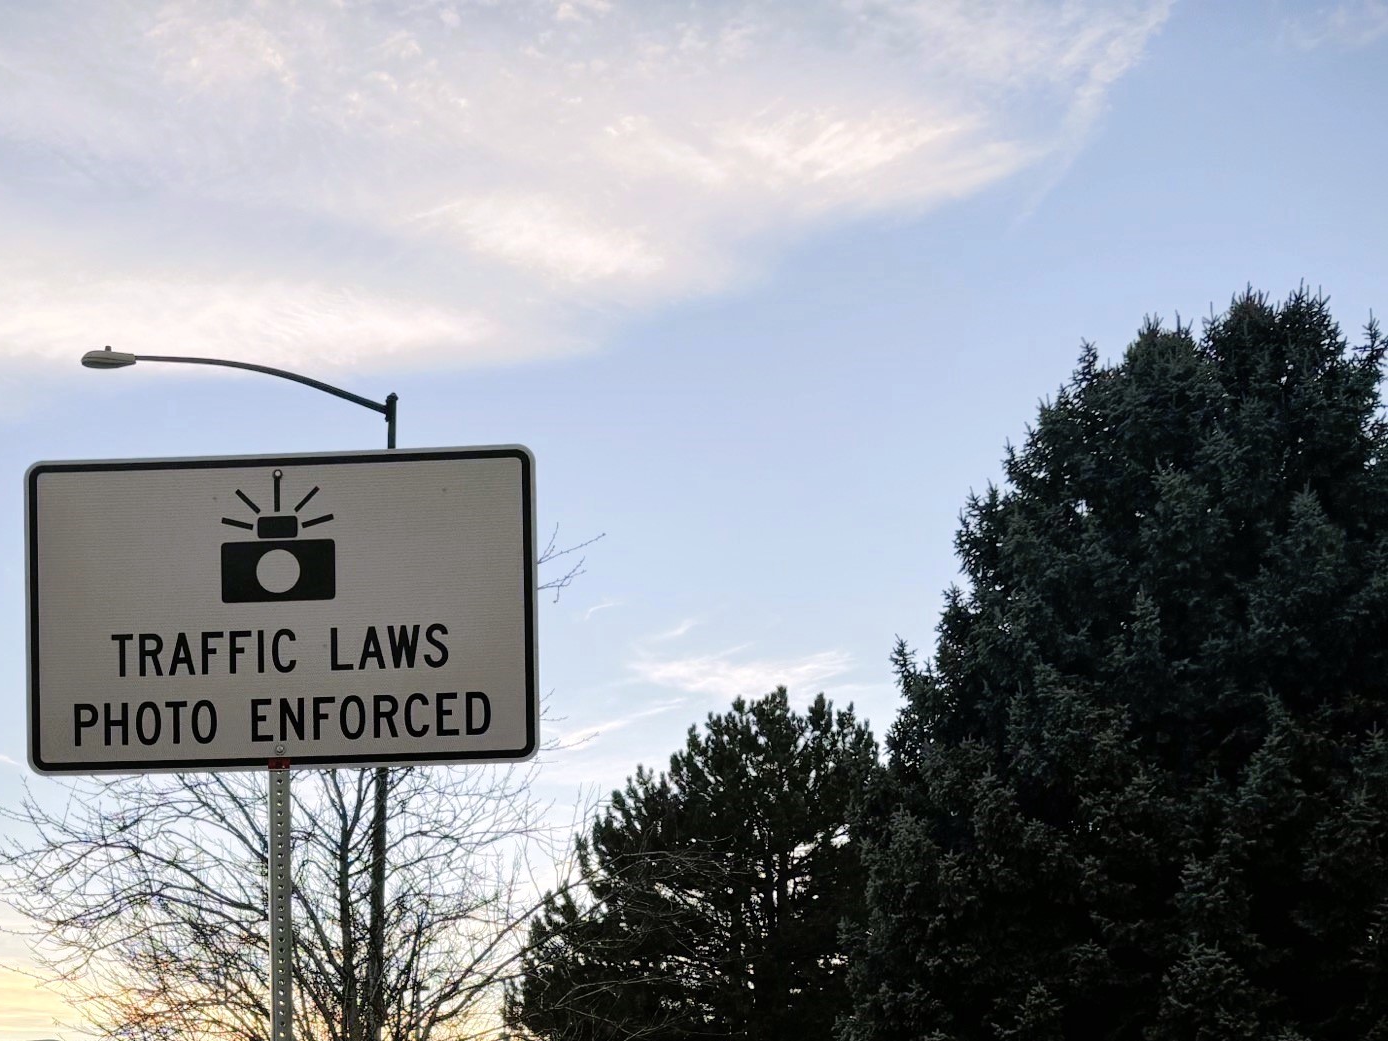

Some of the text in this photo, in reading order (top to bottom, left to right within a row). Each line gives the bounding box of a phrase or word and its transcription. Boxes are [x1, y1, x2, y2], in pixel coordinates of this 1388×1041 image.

[110, 622, 449, 678] TRAFFIC LAWS
[72, 691, 492, 748] PHOTO ENFORCED
